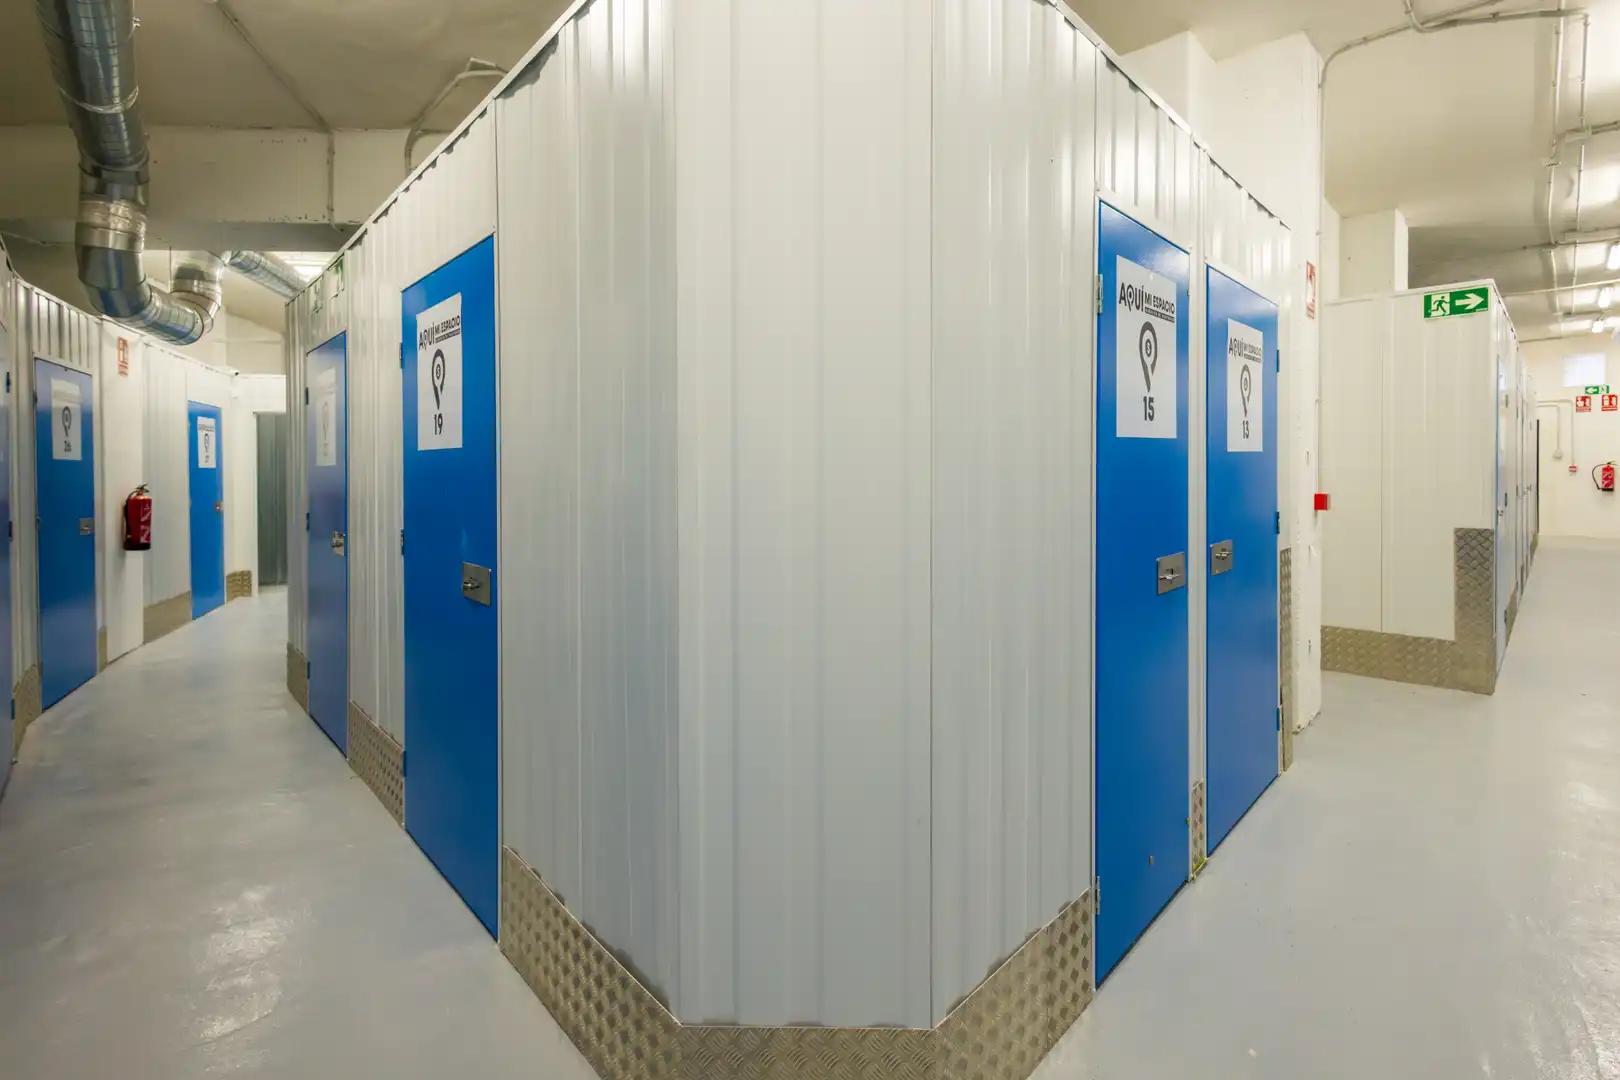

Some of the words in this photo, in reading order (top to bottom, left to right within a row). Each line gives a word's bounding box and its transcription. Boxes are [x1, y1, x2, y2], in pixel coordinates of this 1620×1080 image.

[1144, 291, 1152, 306] MI
[1153, 295, 1175, 315] ESPACIO
[441, 315, 460, 333] ESPACIO
[1143, 396, 1154, 421] 15
[434, 412, 443, 435] 19
[1243, 419, 1250, 440] 13
